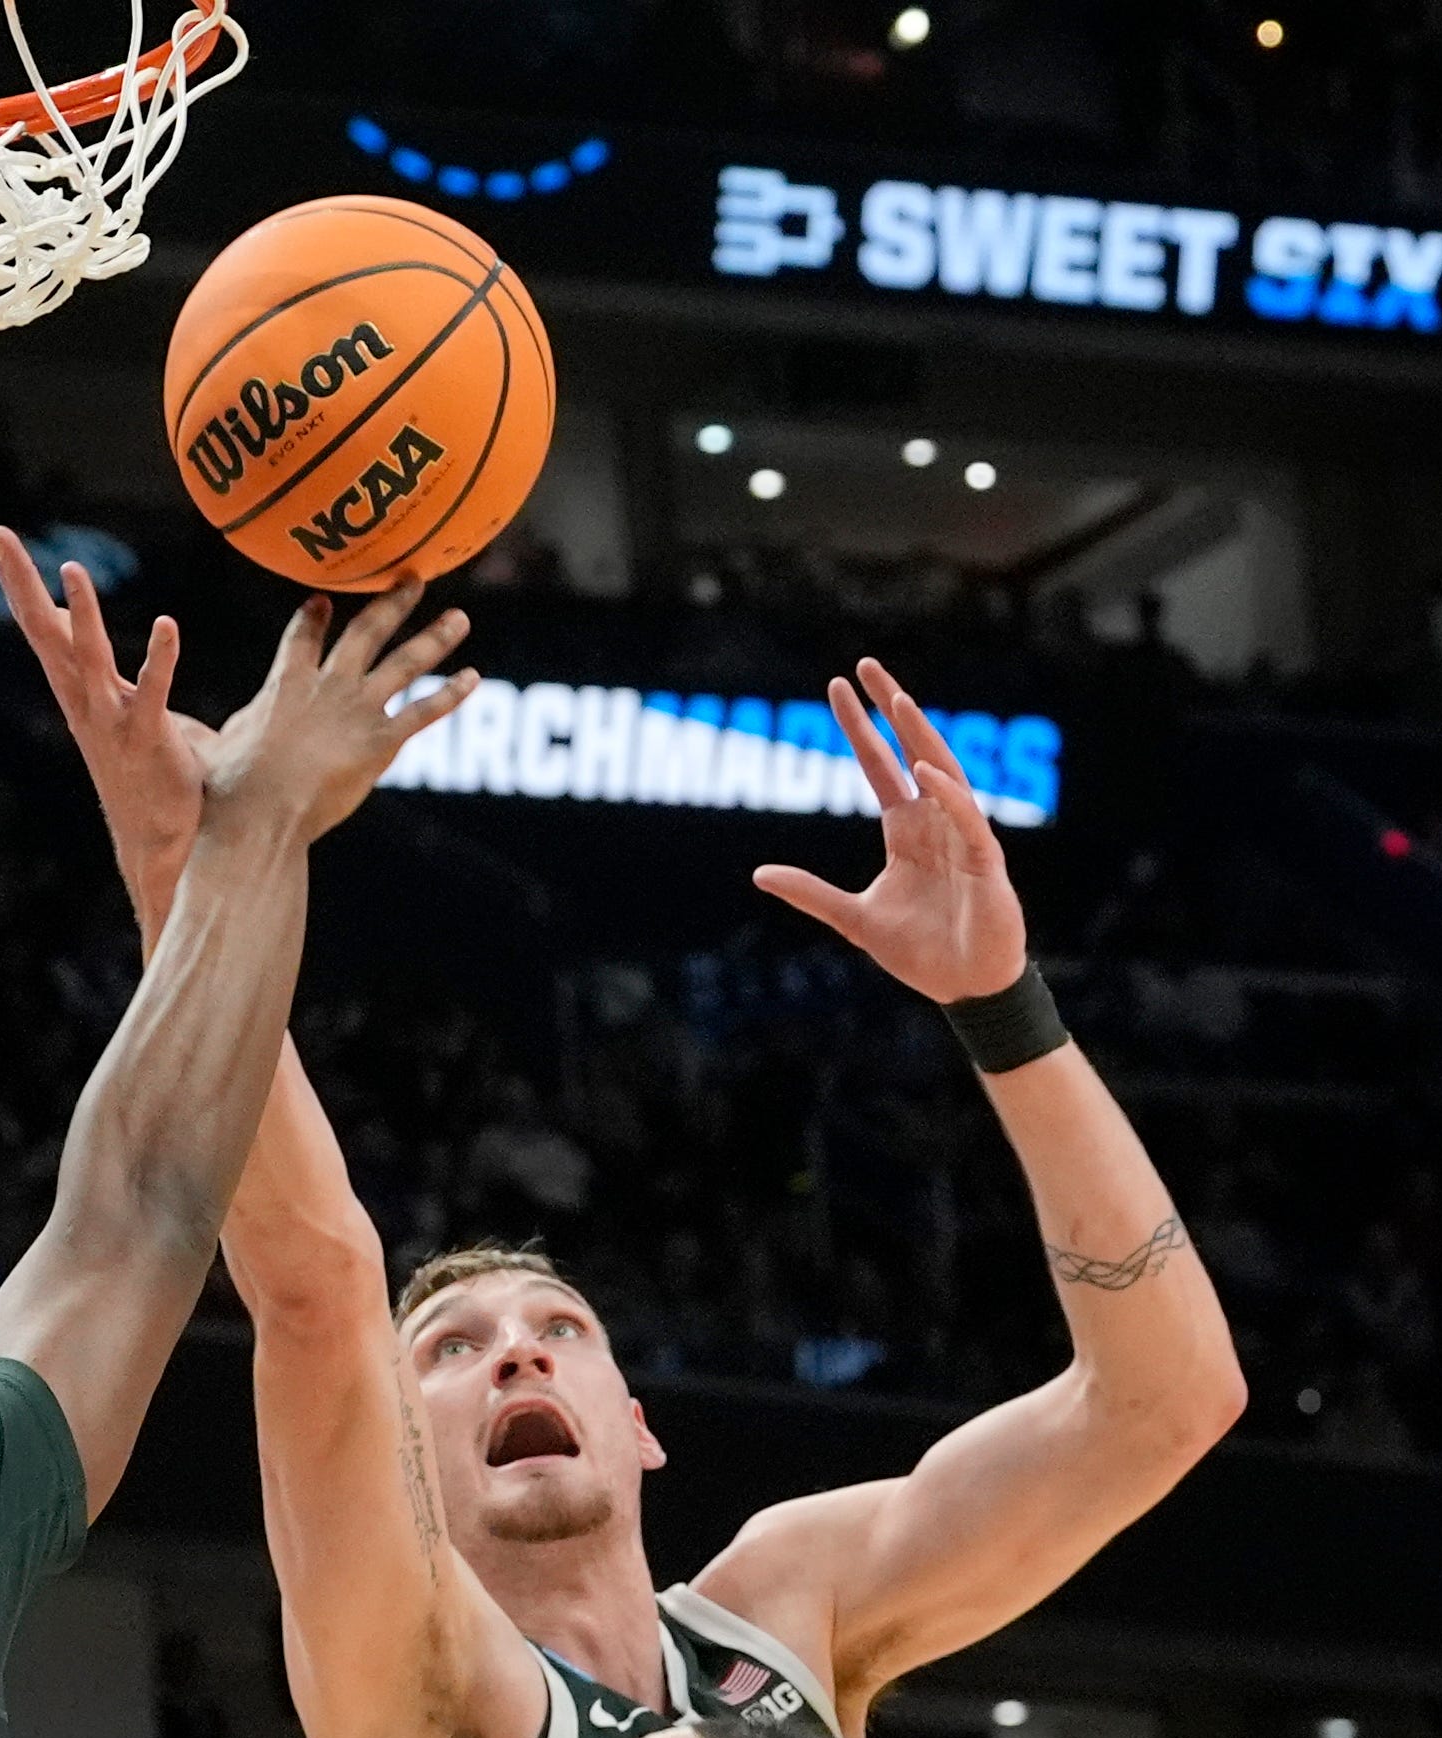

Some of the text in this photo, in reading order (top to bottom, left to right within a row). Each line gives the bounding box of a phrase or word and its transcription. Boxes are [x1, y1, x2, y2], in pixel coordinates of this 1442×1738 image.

[856, 178, 1239, 316] SWEET
[185, 320, 396, 496] Wilson
[268, 410, 327, 467] EVO NXT
[285, 422, 448, 563] NCAA
